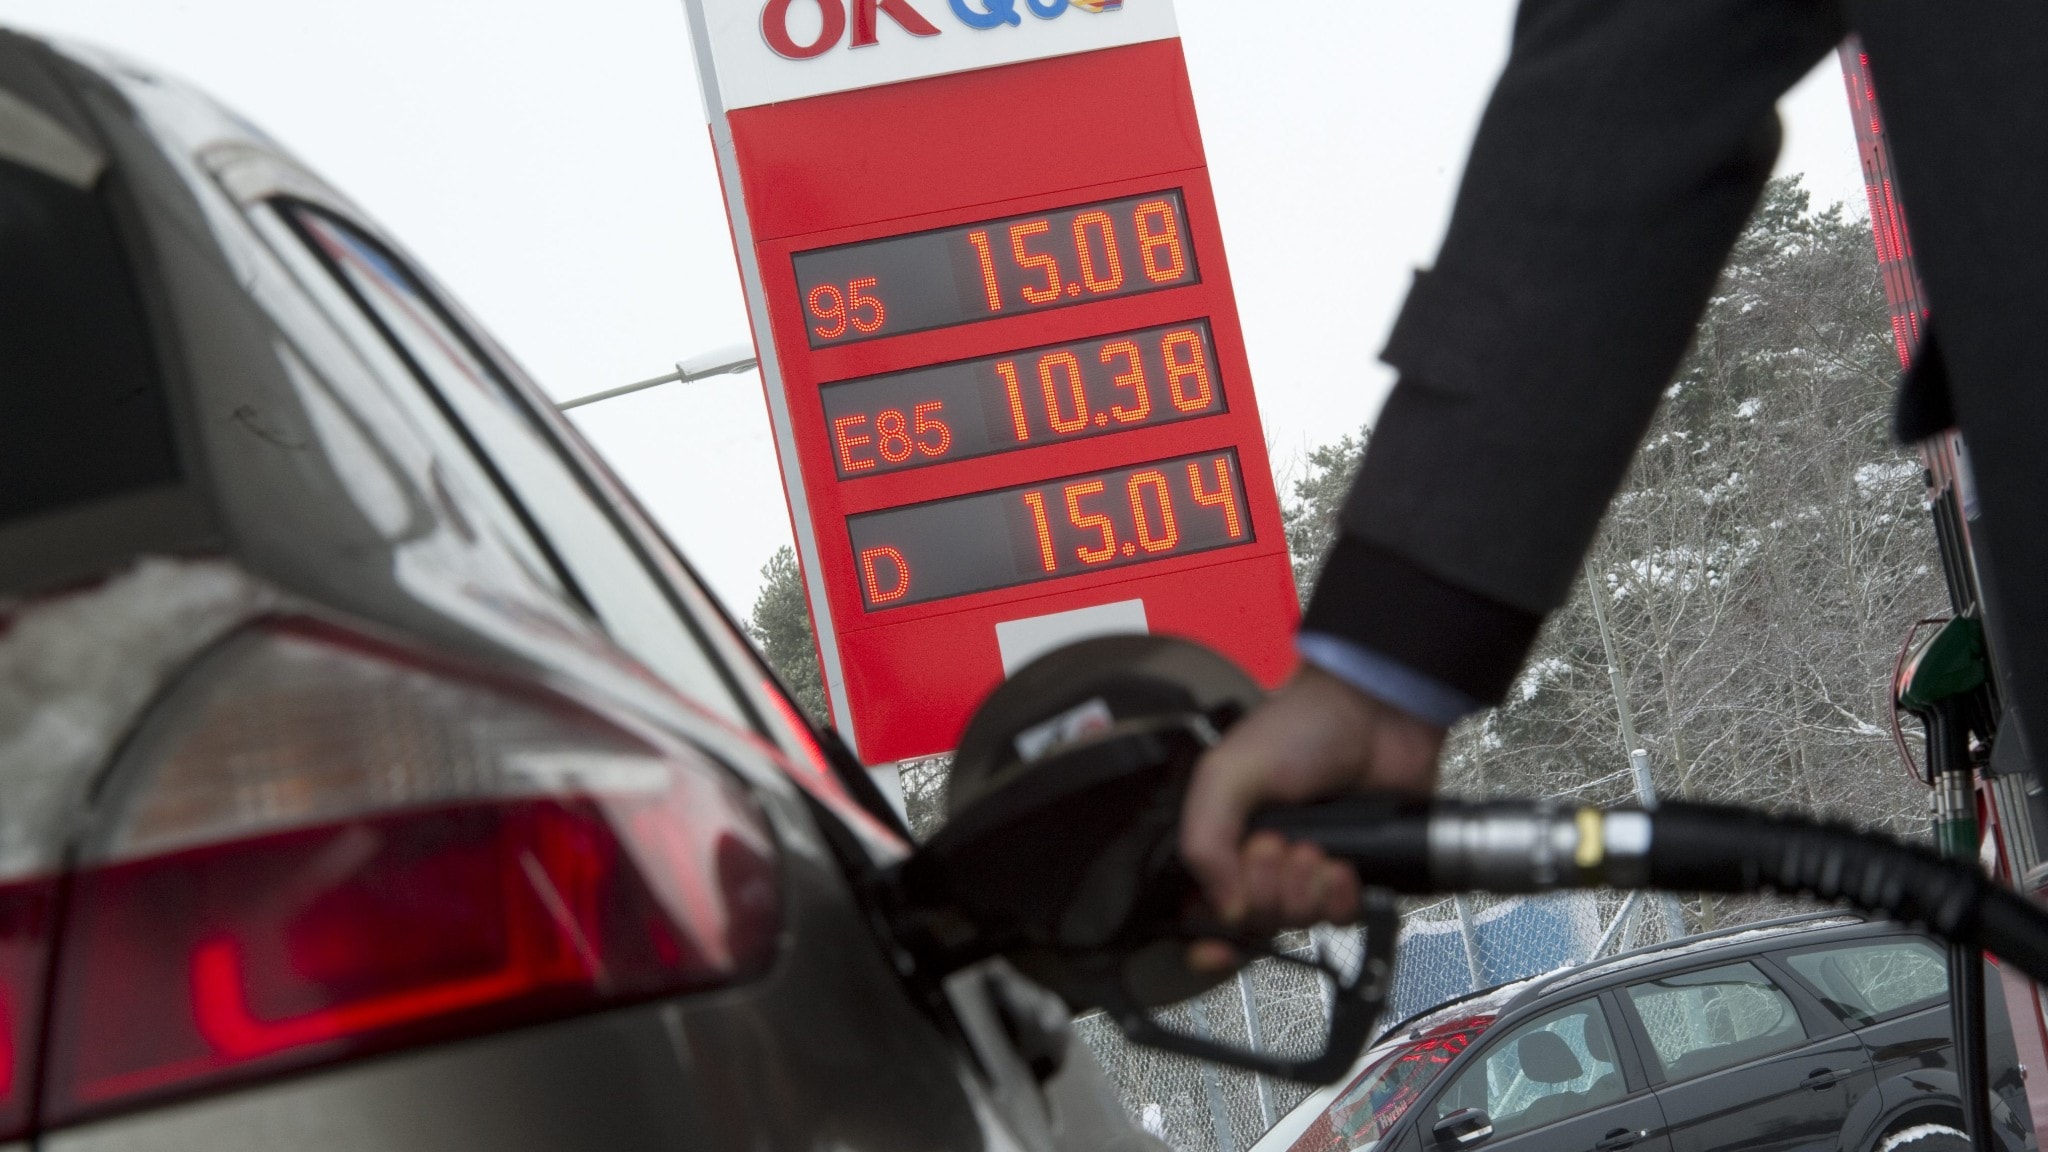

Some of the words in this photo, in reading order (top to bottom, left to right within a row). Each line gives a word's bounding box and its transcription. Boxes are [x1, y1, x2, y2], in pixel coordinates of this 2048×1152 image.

[808, 277, 885, 339] 95
[969, 200, 1185, 311] 15.08
[834, 400, 952, 472] E85
[996, 330, 1213, 442] 10.38
[861, 546, 910, 604] D
[1024, 458, 1242, 573] 15.04
